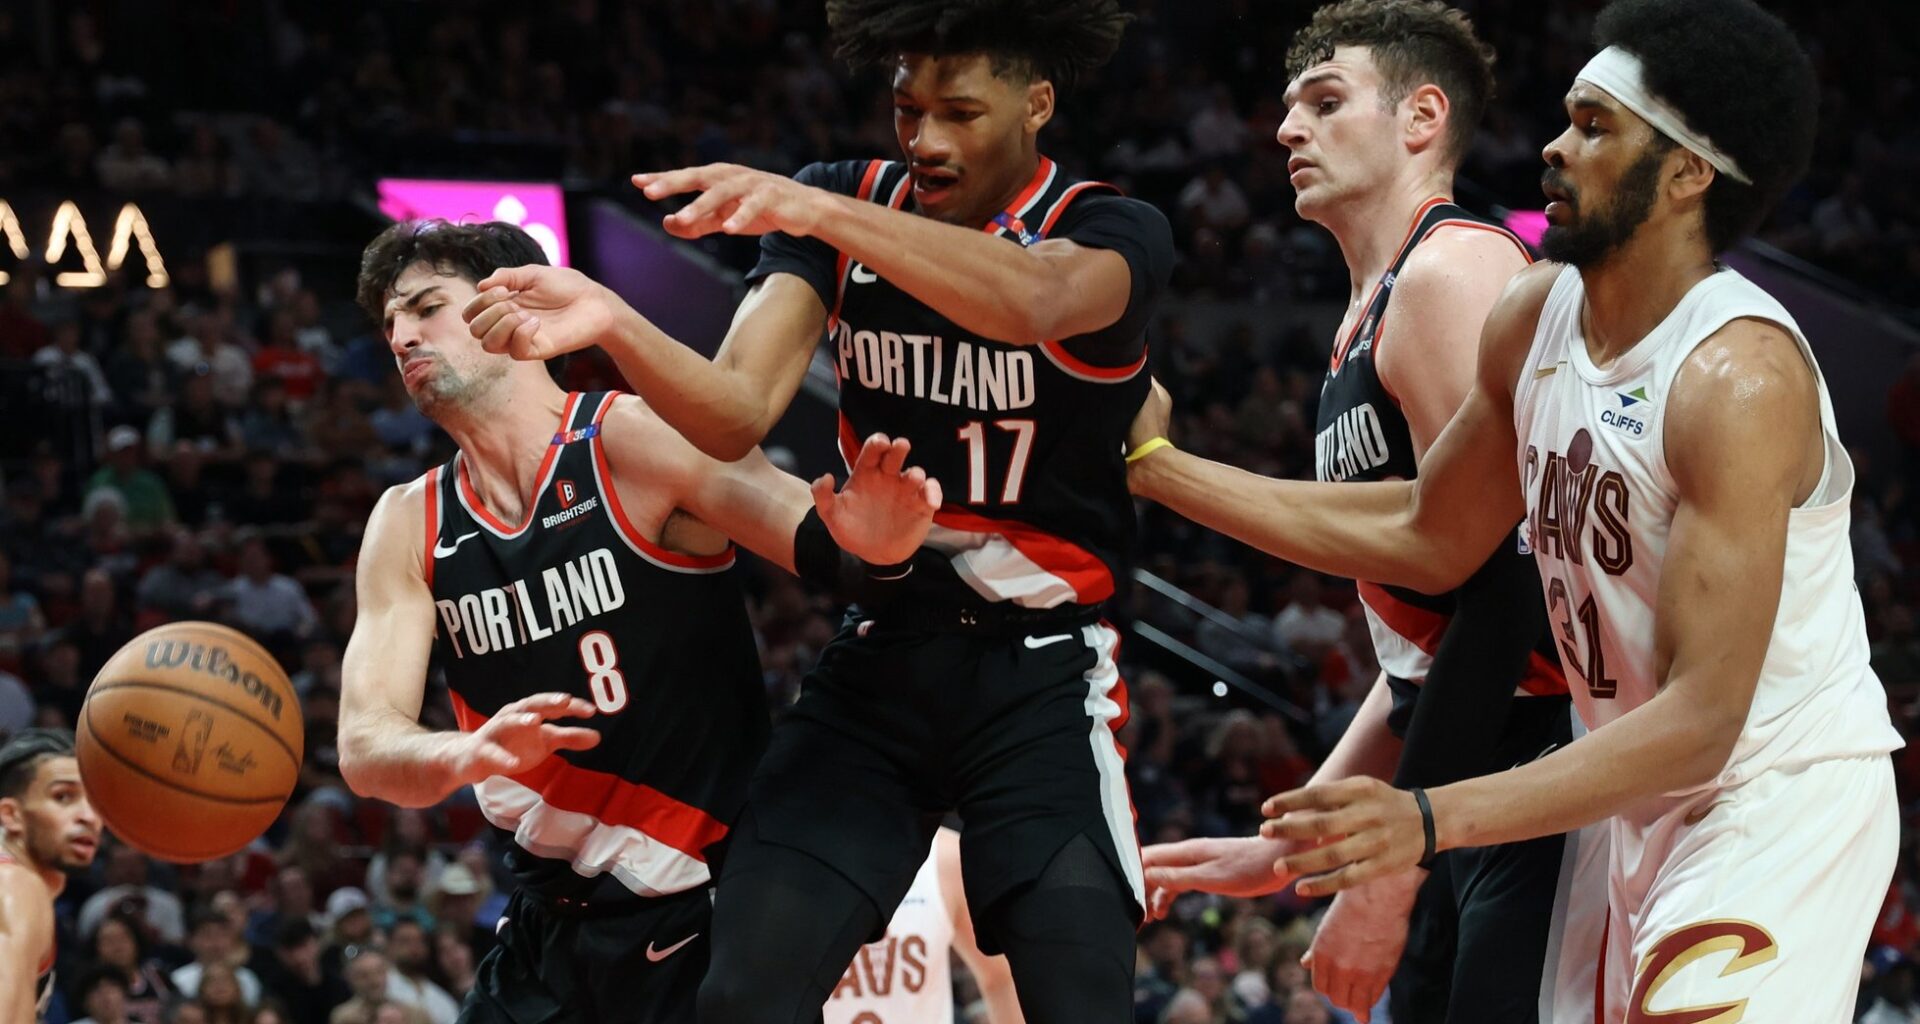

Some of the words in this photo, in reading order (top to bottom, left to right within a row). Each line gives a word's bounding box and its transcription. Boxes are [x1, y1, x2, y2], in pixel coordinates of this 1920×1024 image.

[838, 319, 1036, 411] PORTLAND
[573, 428, 587, 441] 32
[957, 419, 1036, 505] 17
[1315, 402, 1389, 482] RTLAND
[1600, 410, 1644, 435] CLIFFS
[542, 496, 598, 529] BRIGHTSIDE
[436, 548, 625, 659] PORTLAND
[1549, 577, 1617, 699] 31
[145, 640, 283, 721] Wilson
[577, 630, 630, 715] 8
[833, 934, 926, 999] AVS
